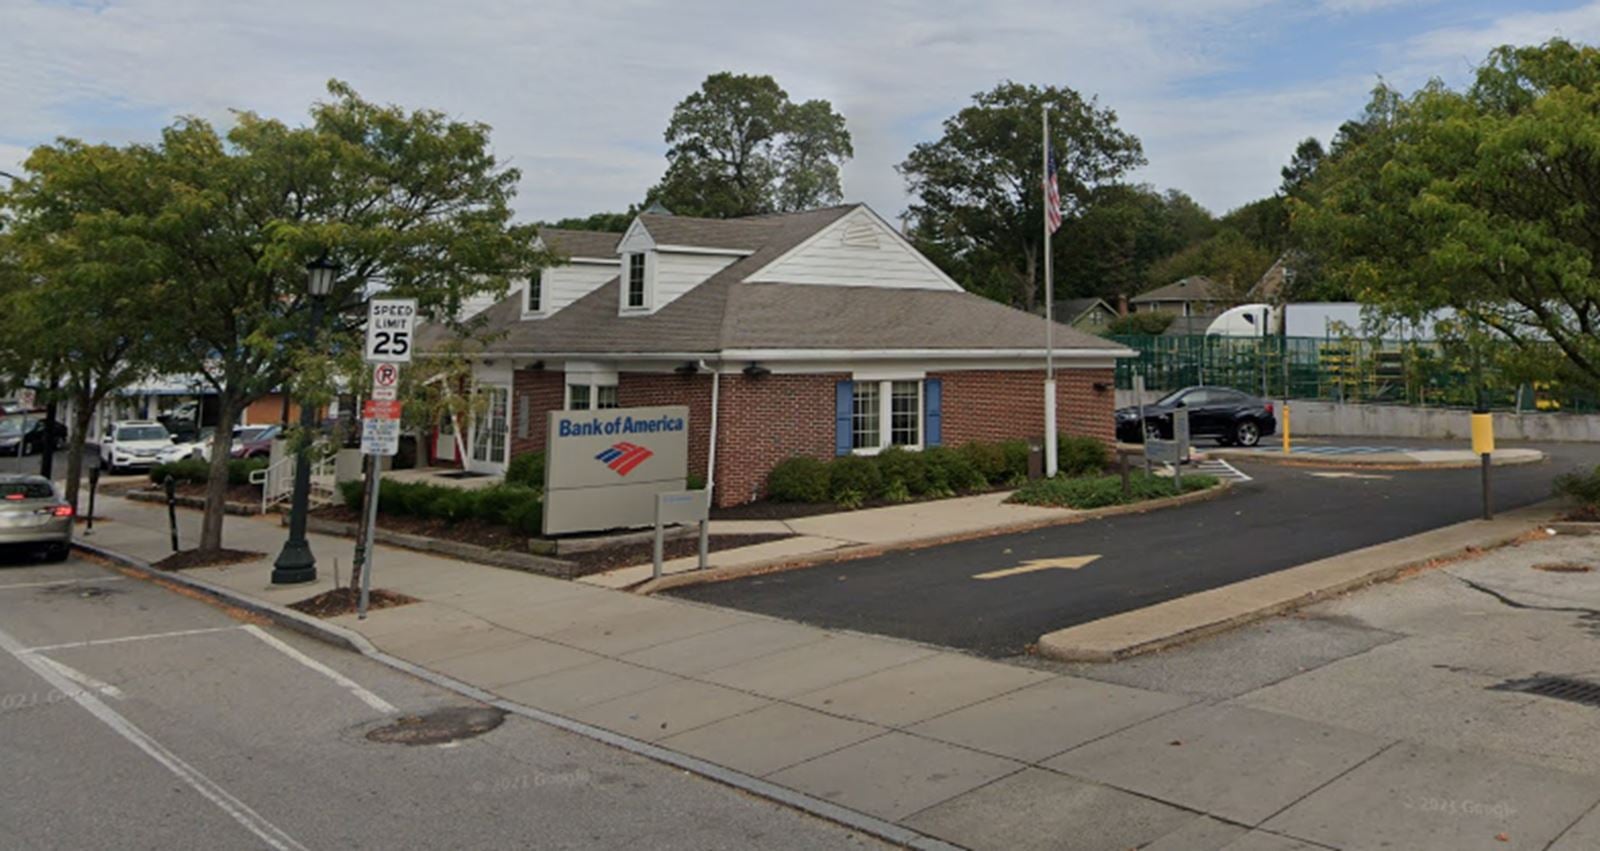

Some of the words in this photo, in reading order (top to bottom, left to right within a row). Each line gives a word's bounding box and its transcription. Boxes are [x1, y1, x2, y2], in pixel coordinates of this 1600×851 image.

[373, 305, 413, 316] SPEED
[375, 318, 406, 329] LIMIT
[373, 332, 408, 355] 25
[559, 417, 602, 437] Bank
[605, 416, 621, 435] of
[623, 415, 683, 433] America
